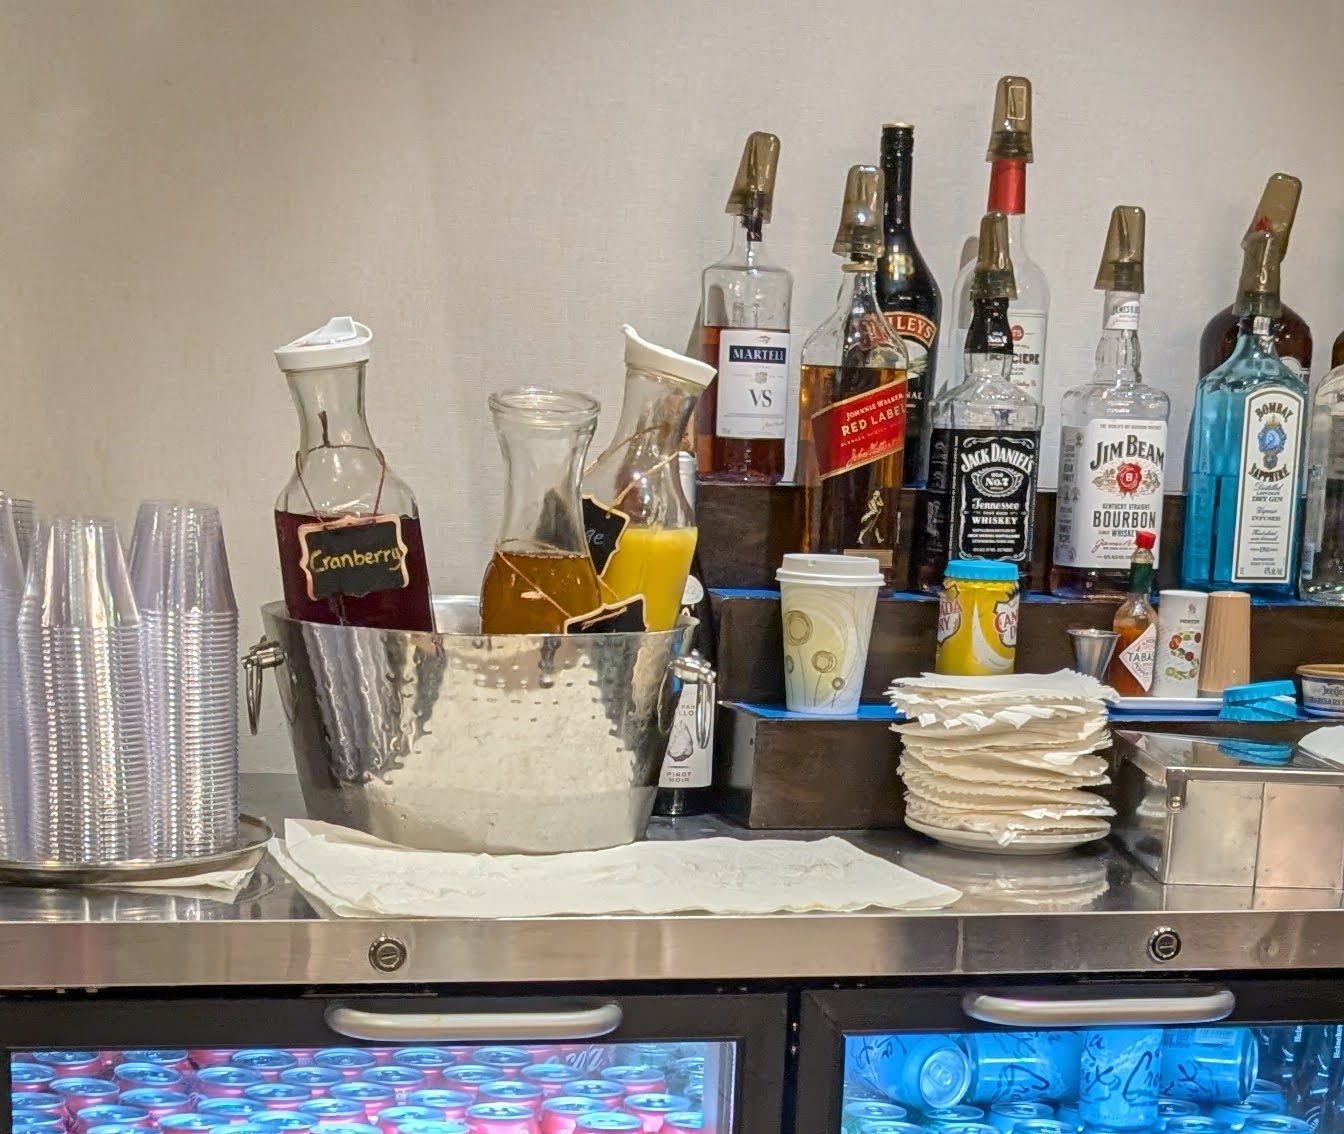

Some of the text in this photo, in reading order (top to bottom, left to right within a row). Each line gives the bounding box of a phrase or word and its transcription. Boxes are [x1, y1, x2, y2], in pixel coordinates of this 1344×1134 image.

[749, 389, 773, 408] VS
[841, 419, 868, 437] RED
[870, 403, 906, 426] LABEL
[1255, 402, 1294, 423] BOMBAY
[961, 448, 990, 473] JACK
[1090, 434, 1164, 472] JIM BEAM
[1248, 463, 1290, 482] SAPPHIRE
[972, 498, 1020, 510] Tennessee
[972, 516, 1018, 525] WHISKEY
[1093, 511, 1156, 529] BOURBON
[310, 546, 404, 578] Cranberry
